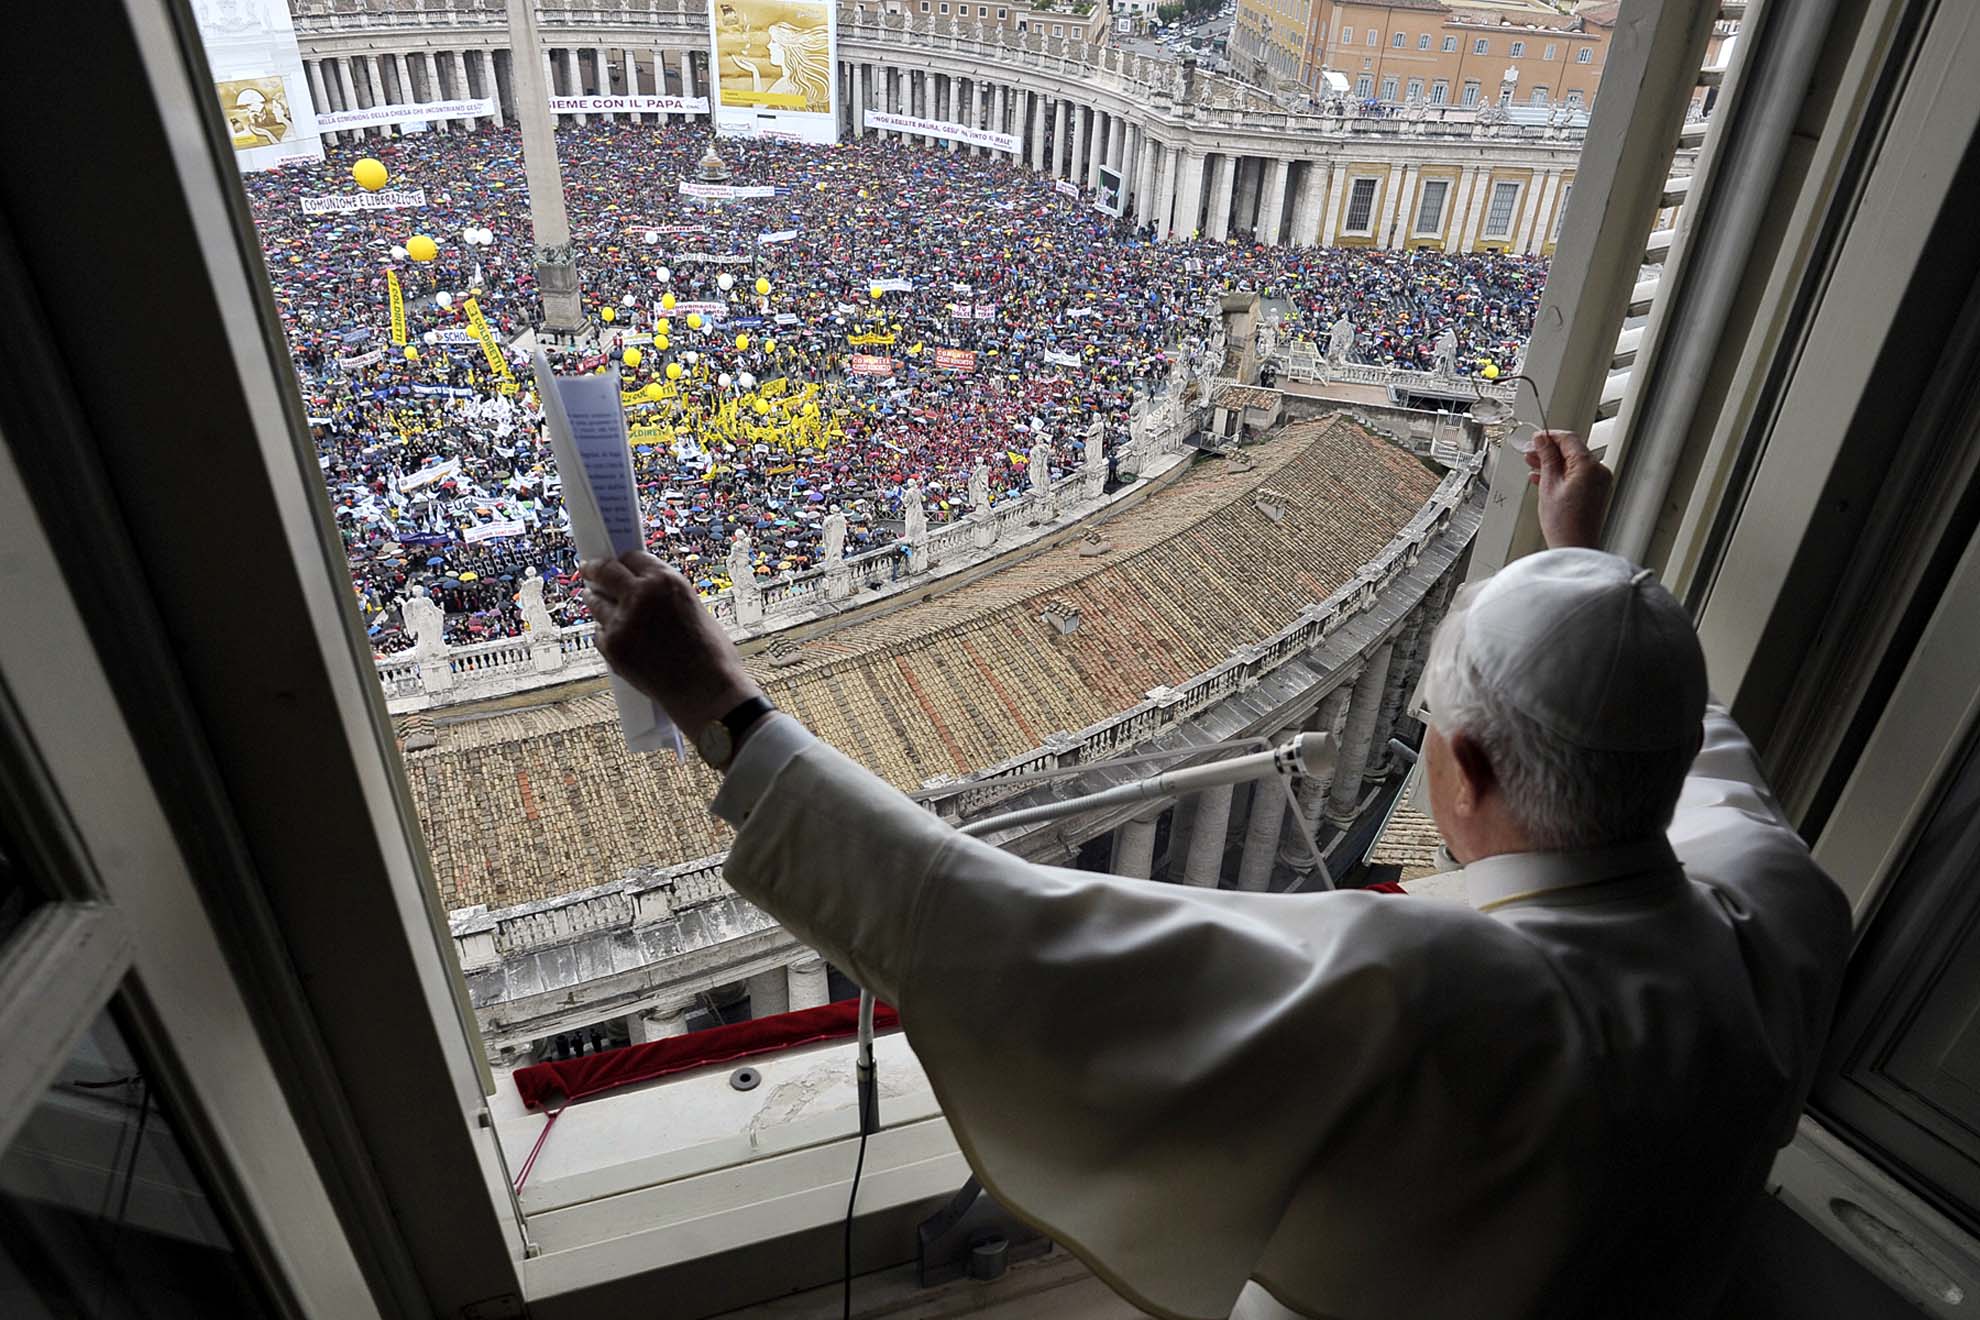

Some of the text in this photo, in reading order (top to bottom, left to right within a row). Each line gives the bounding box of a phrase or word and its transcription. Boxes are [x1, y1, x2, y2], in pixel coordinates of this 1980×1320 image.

[592, 99, 624, 109] CON
[629, 99, 642, 108] IL
[646, 99, 683, 109] PAPA
[370, 112, 389, 120] DELLA
[391, 109, 412, 117] CHIESA
[304, 192, 422, 211] COMUNIONE E LIBERAZIONE
[475, 317, 503, 369] COLDIRETTI
